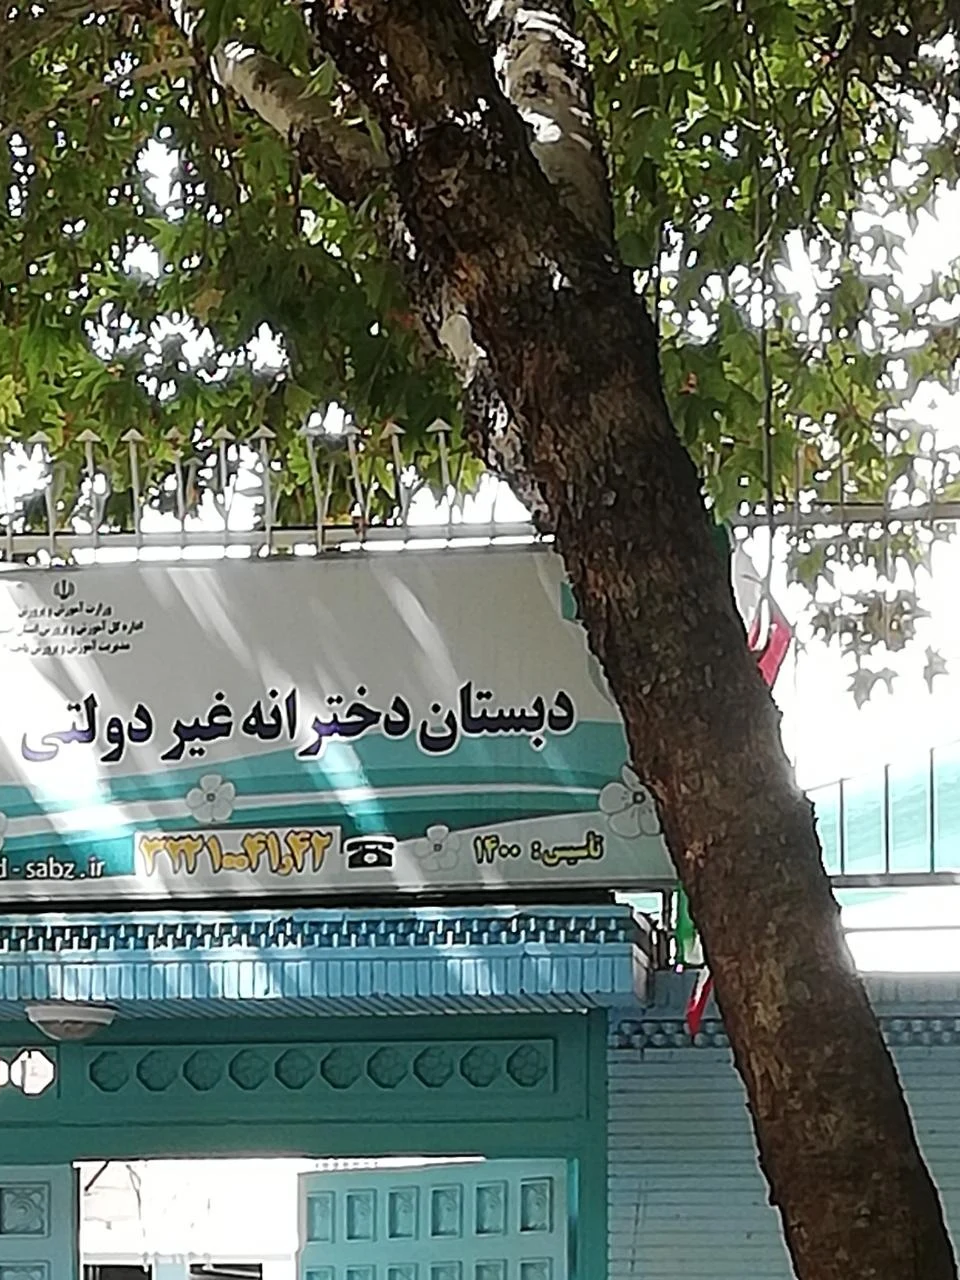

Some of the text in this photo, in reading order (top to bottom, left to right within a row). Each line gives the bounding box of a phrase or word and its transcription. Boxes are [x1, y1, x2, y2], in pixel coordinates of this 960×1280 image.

[21, 692, 154, 763] دولتی
[160, 691, 234, 762] غیر
[417, 681, 576, 754] دبستان
[473, 834, 522, 864] ۱۴۰۰
